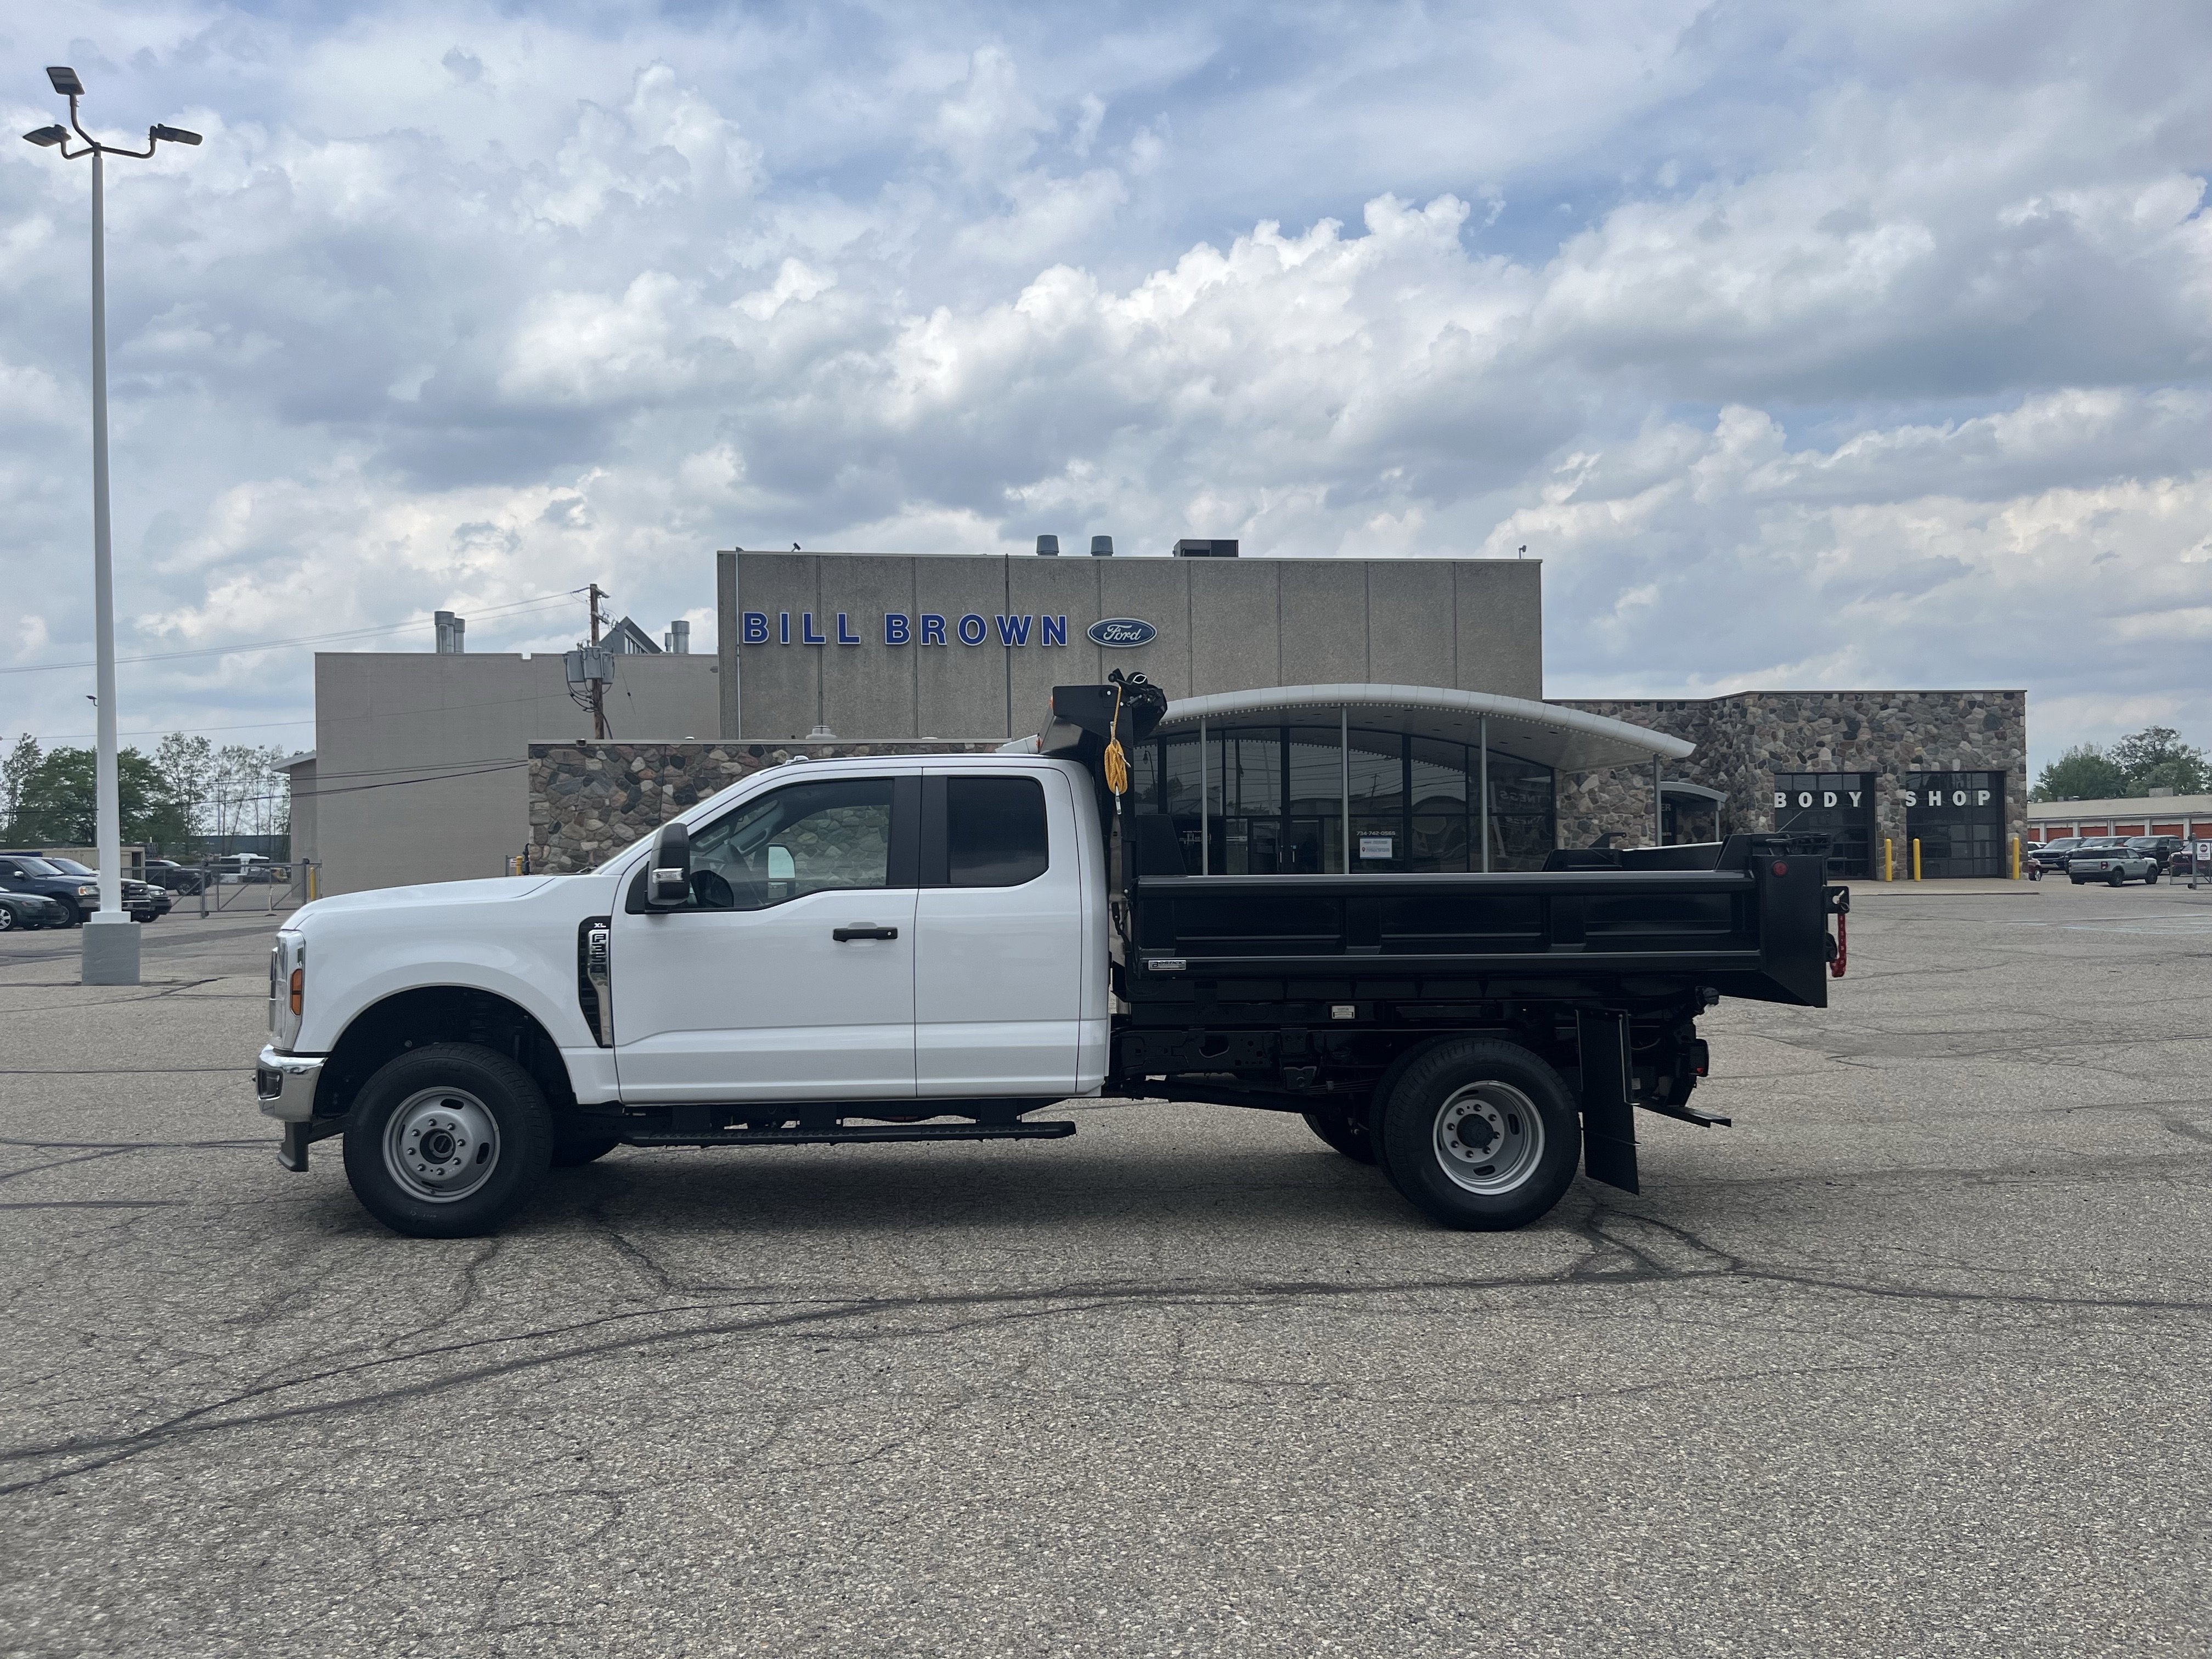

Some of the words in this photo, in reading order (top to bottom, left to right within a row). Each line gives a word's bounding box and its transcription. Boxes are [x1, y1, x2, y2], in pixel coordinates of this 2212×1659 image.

[743, 612, 861, 645] BILL
[884, 613, 1068, 646] BROWN
[1103, 624, 1142, 641] Ford
[1774, 791, 1862, 808] BODY
[1905, 790, 1991, 806] SHOP
